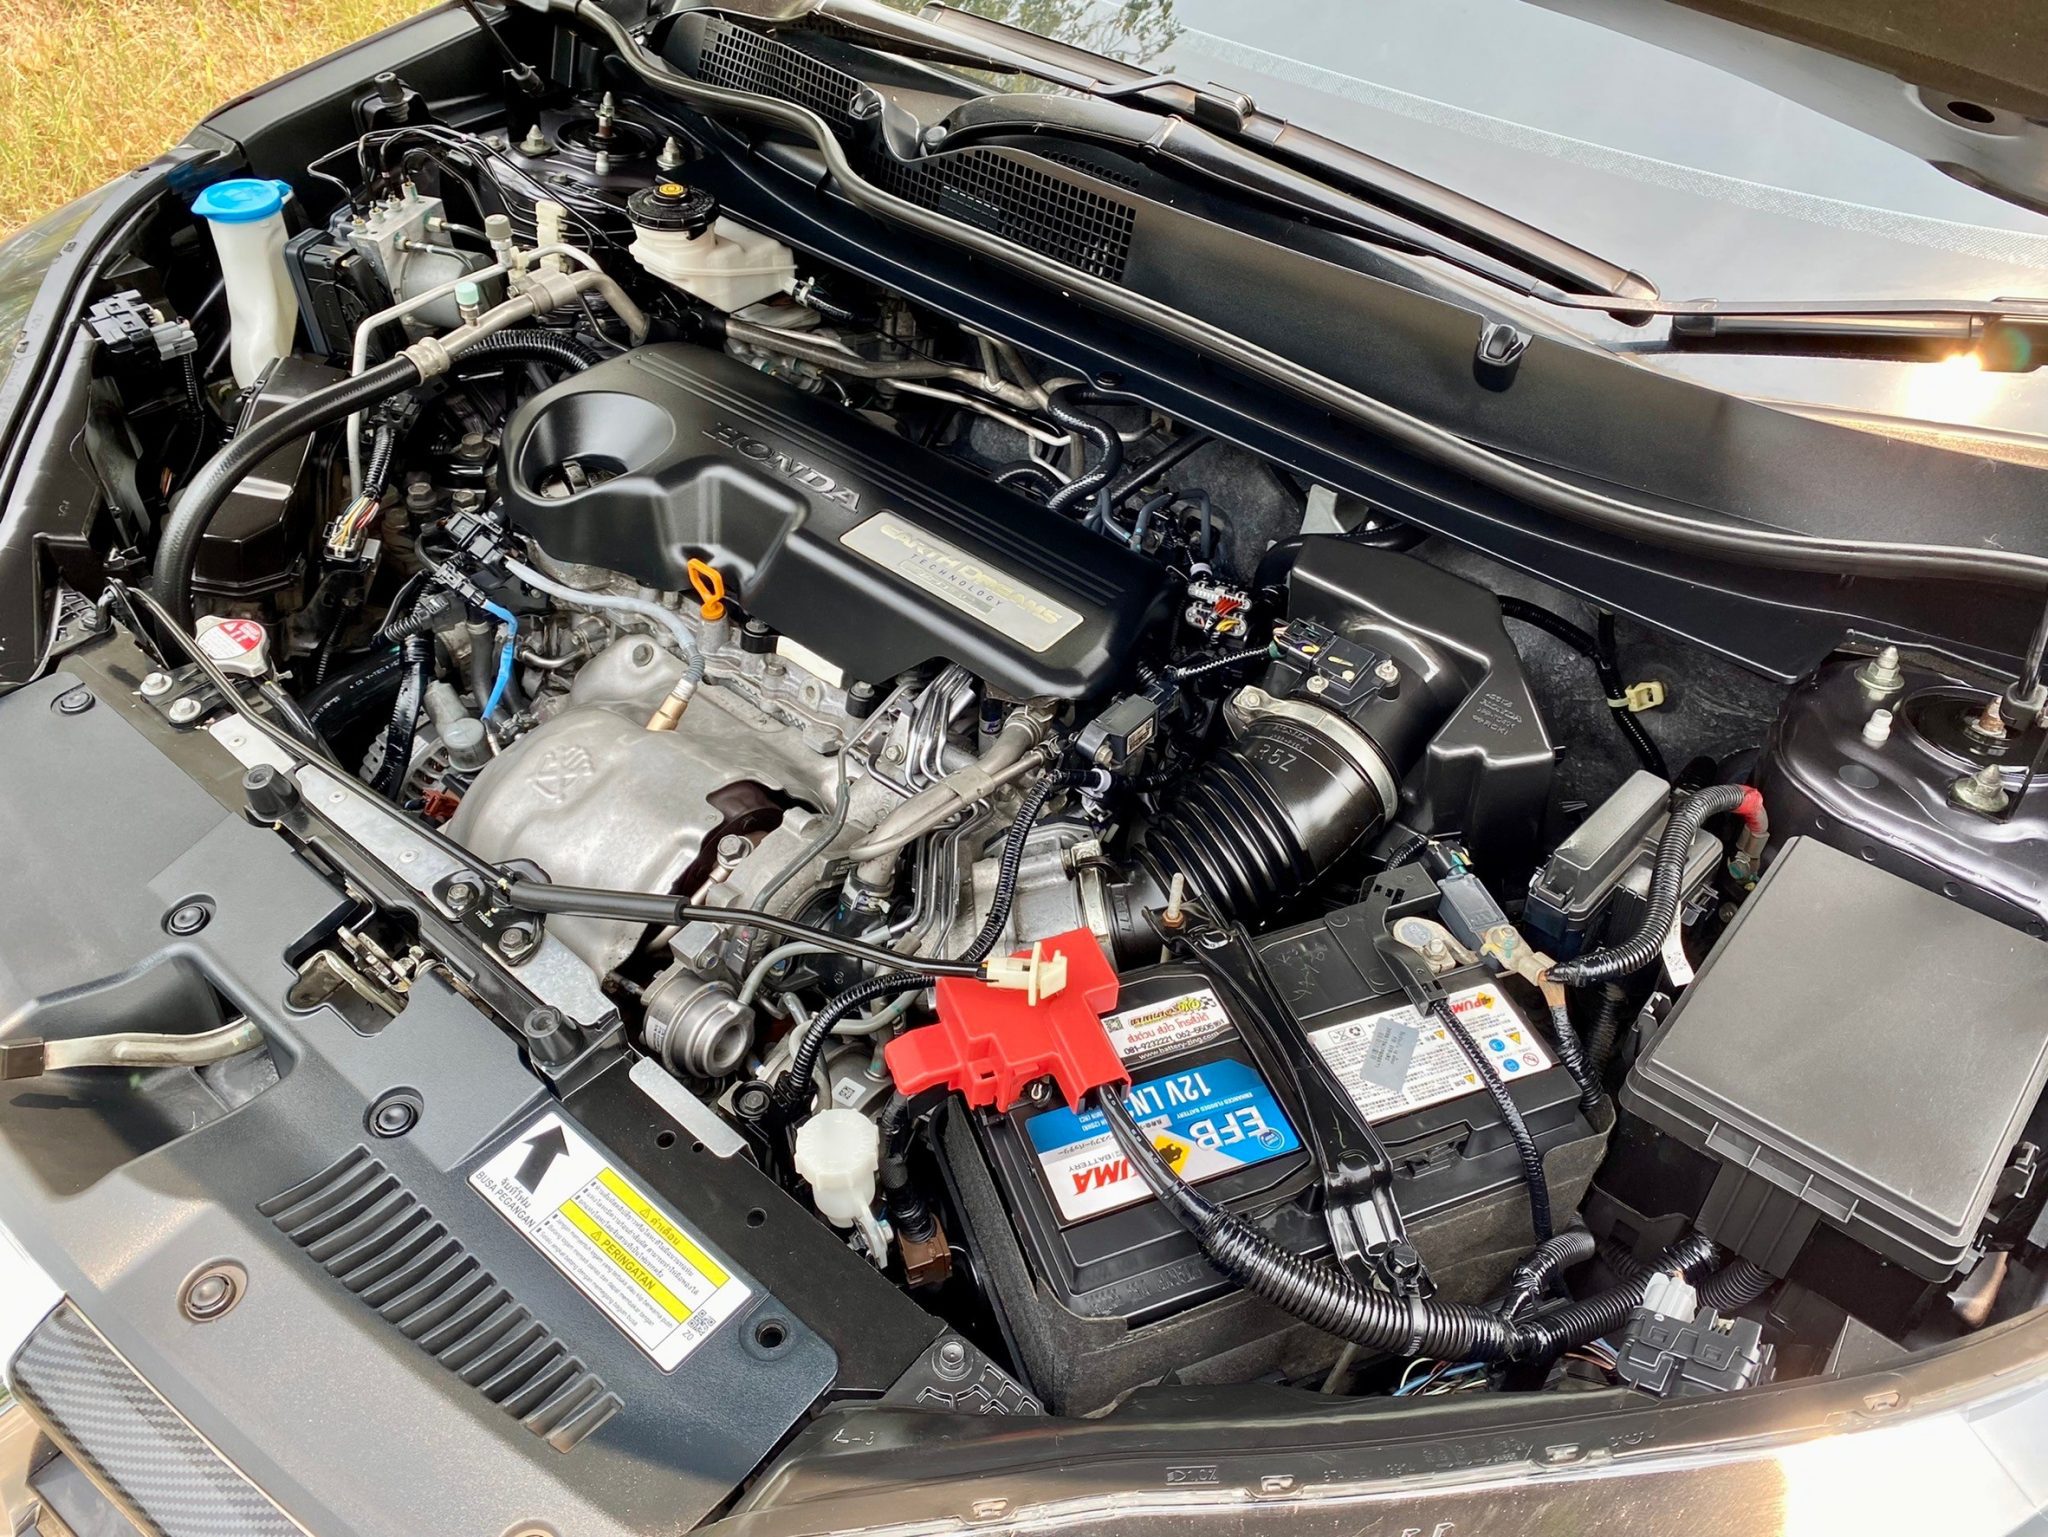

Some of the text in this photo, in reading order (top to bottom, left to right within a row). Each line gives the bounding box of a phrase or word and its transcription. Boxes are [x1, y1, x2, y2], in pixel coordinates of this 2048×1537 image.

[702, 422, 862, 513] HONDA
[911, 554, 1002, 606] TECHNOLOGY
[1163, 1072, 1211, 1106] 12V
[1176, 1092, 1253, 1119] ENHANCED FLOODED BATTERY
[1185, 1105, 1267, 1152] EFB
[1069, 1154, 1111, 1172] BATTERY
[1072, 1161, 1137, 1195] UMA
[476, 1171, 535, 1229] BUSA PEGANGAN
[648, 1215, 683, 1246] คำเตือน
[599, 1238, 656, 1291] PERINGATAN
